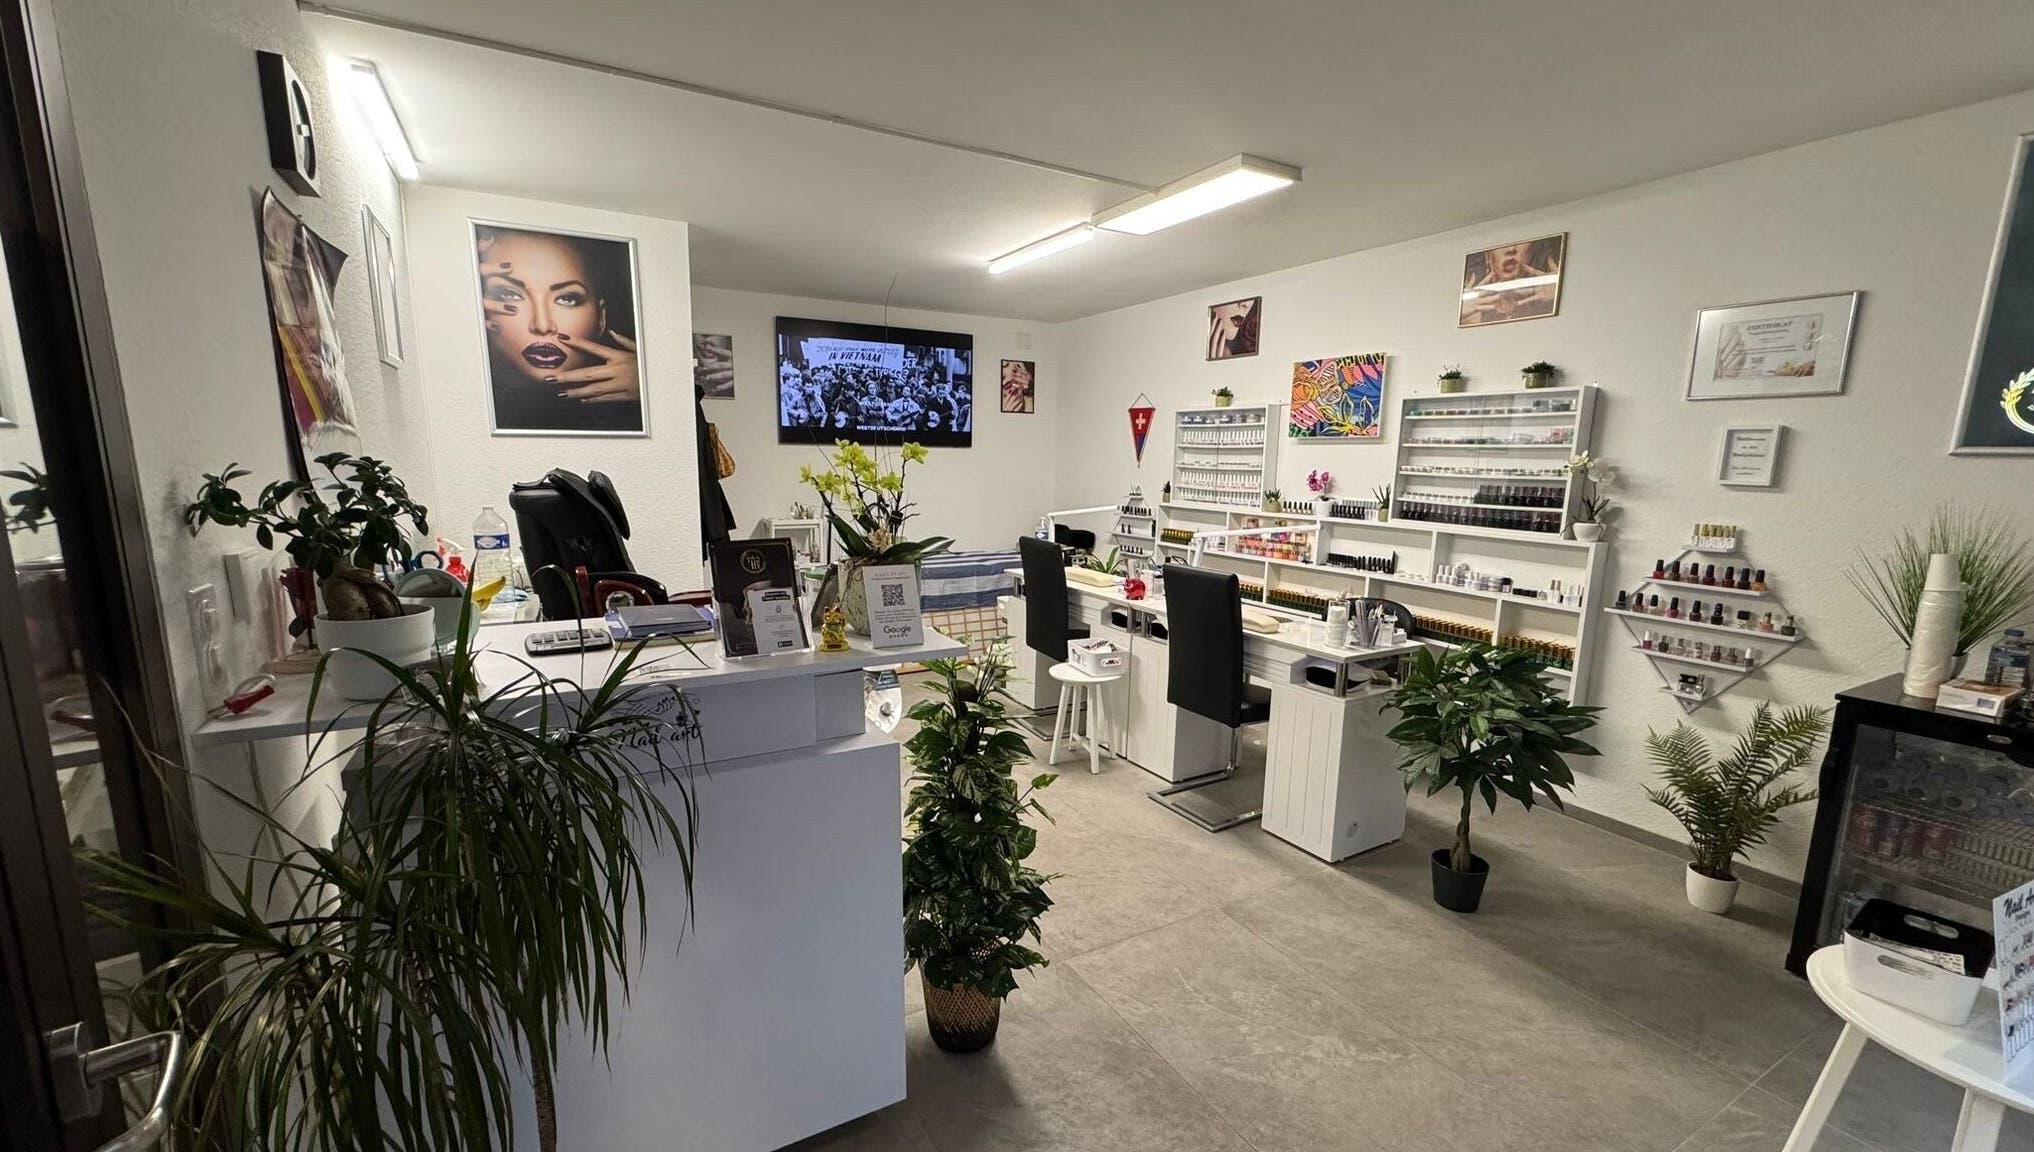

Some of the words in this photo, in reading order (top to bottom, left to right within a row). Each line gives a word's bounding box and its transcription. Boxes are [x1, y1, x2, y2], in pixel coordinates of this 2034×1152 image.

[840, 352, 882, 363] VIETNAM
[883, 625, 912, 634] Google
[2003, 893, 2024, 918] Nail
